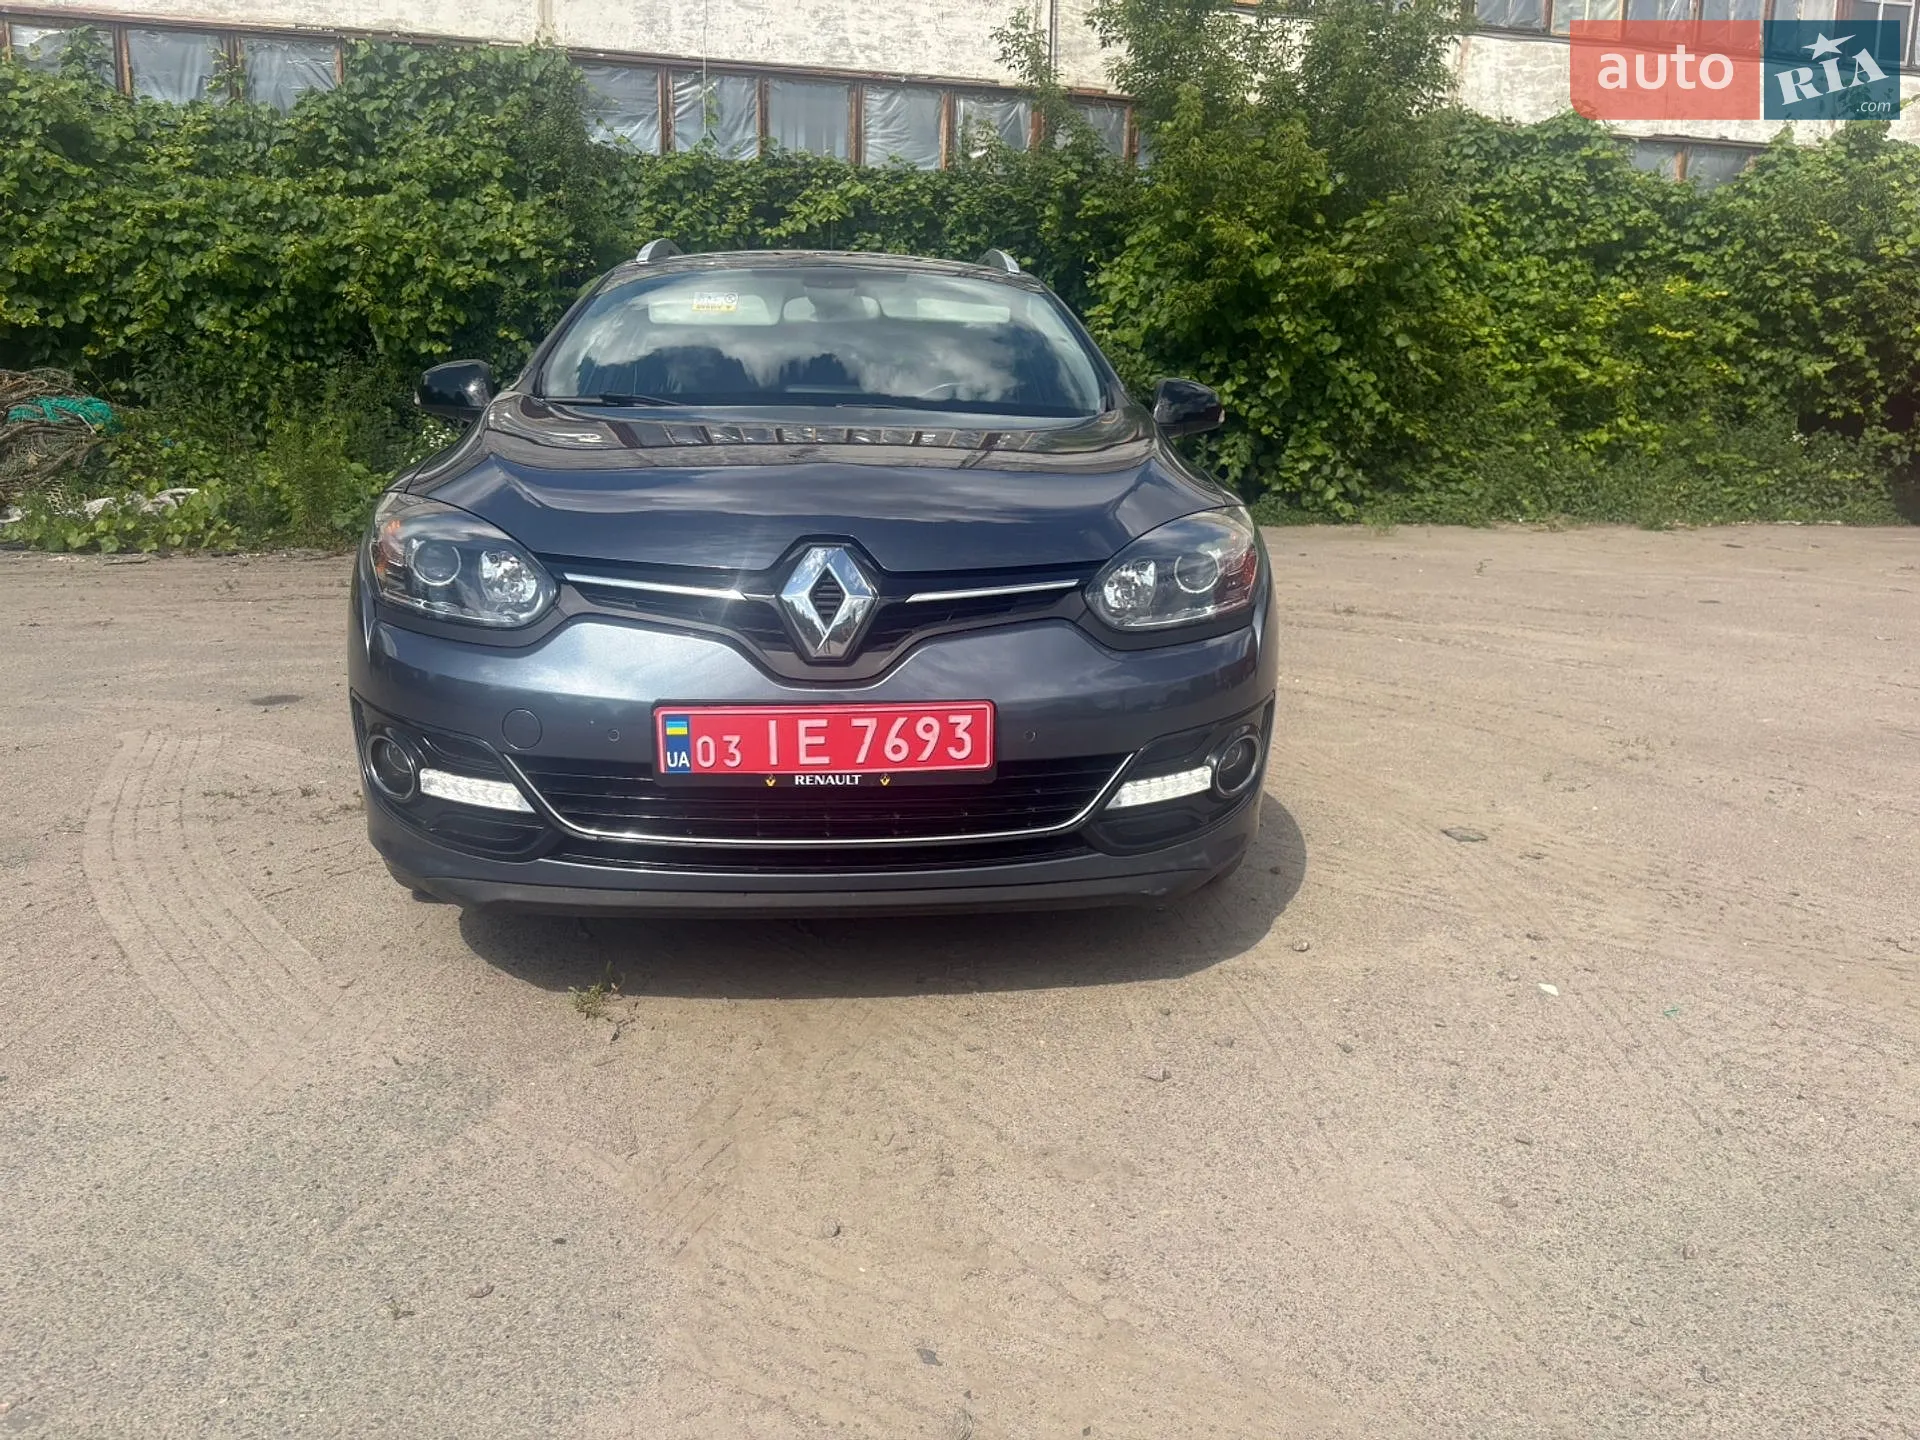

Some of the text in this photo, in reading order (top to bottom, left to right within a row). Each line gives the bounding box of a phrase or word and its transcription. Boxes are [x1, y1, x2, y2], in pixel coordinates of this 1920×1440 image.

[696, 714, 973, 768] 03 IE 7693
[666, 751, 690, 768] UA
[794, 774, 862, 786] RENAULT
